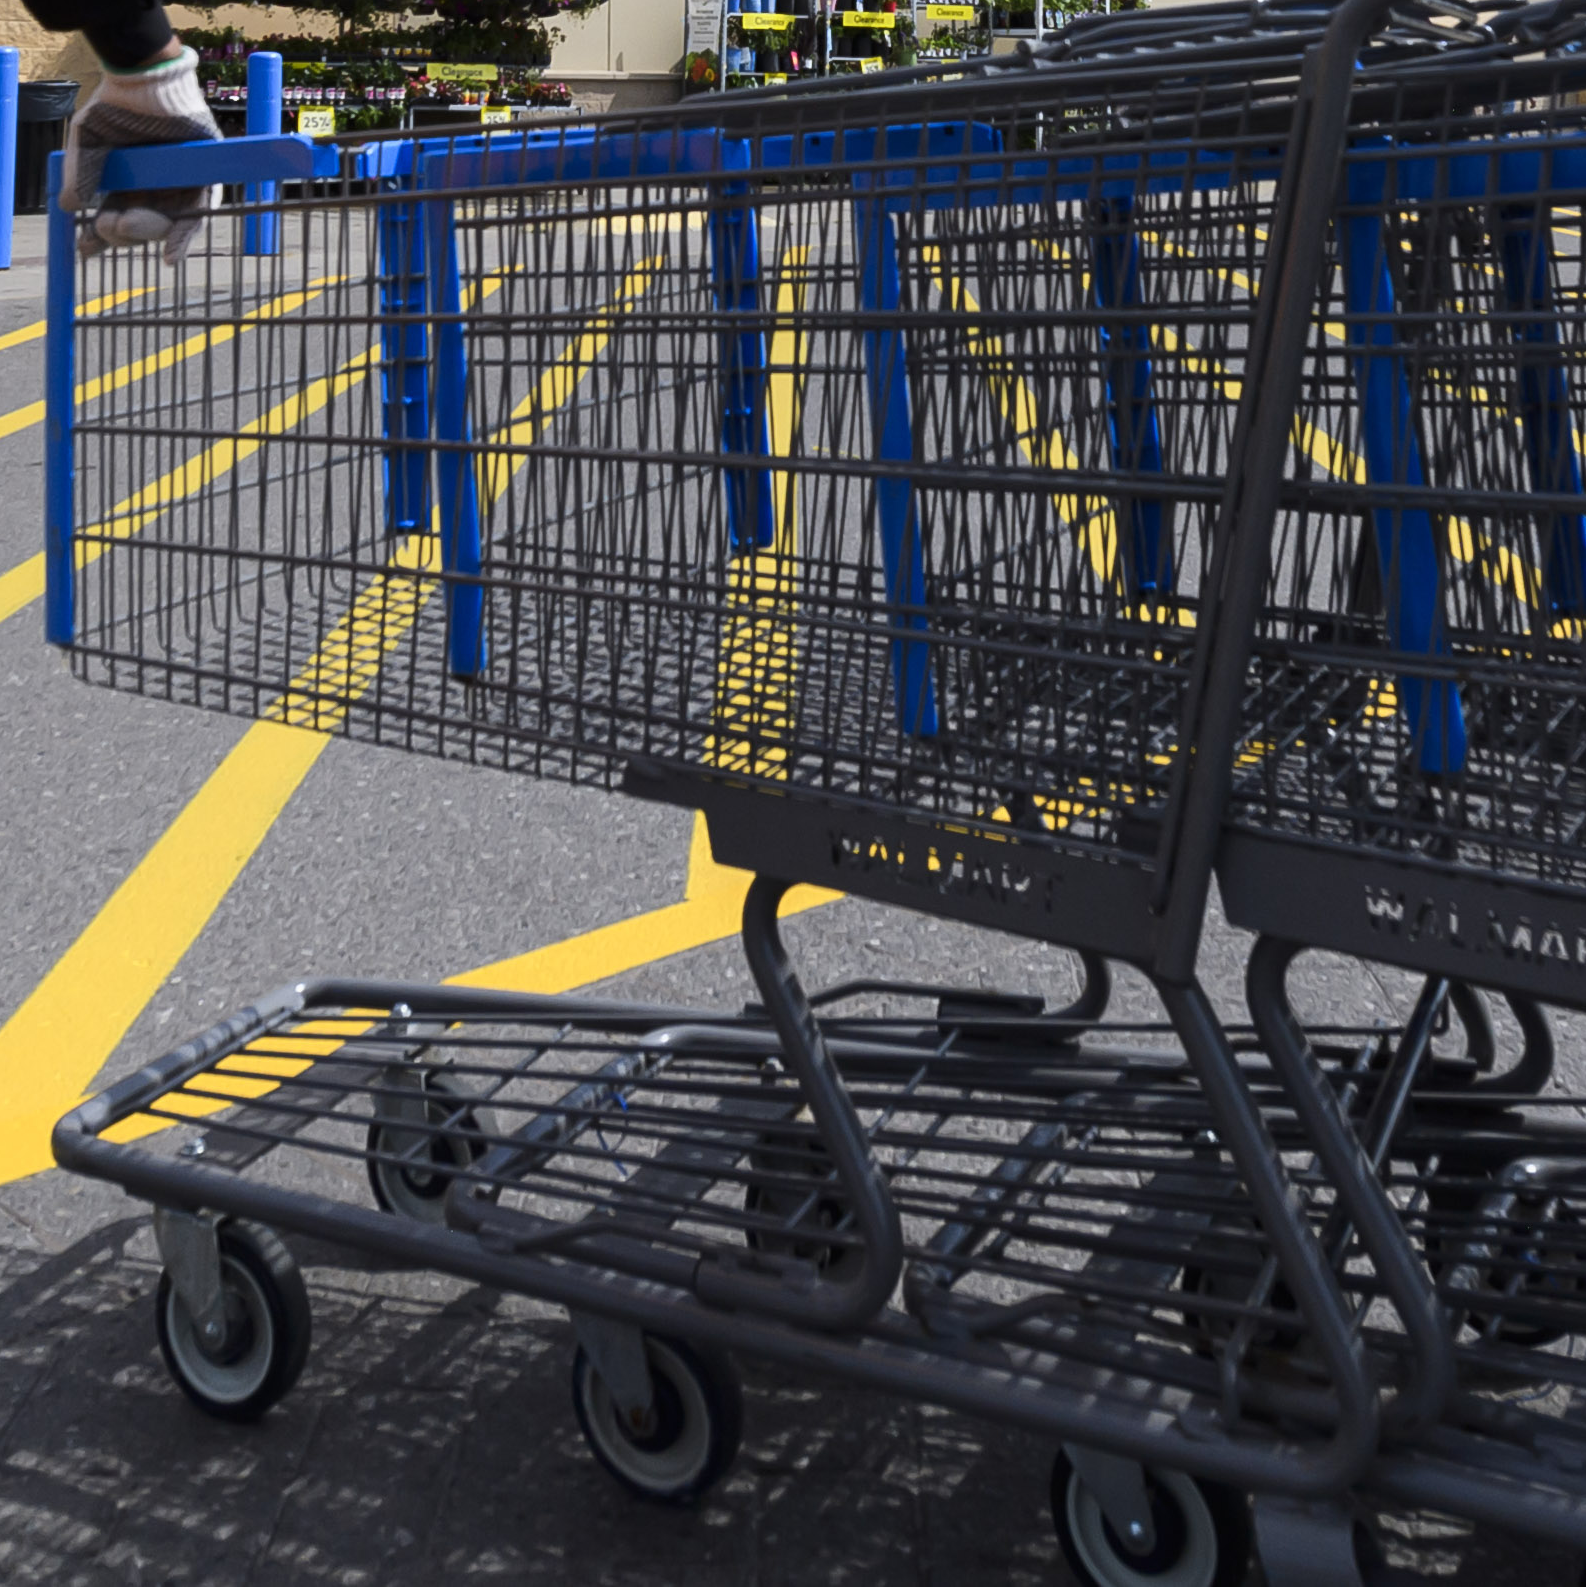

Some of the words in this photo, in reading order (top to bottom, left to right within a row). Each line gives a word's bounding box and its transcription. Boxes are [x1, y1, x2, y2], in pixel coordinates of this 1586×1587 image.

[936, 7, 965, 17] Clearance
[754, 16, 785, 26] Clearance
[853, 14, 885, 24] Clearance
[441, 66, 483, 77] Clearance
[303, 116, 330, 129] 25%
